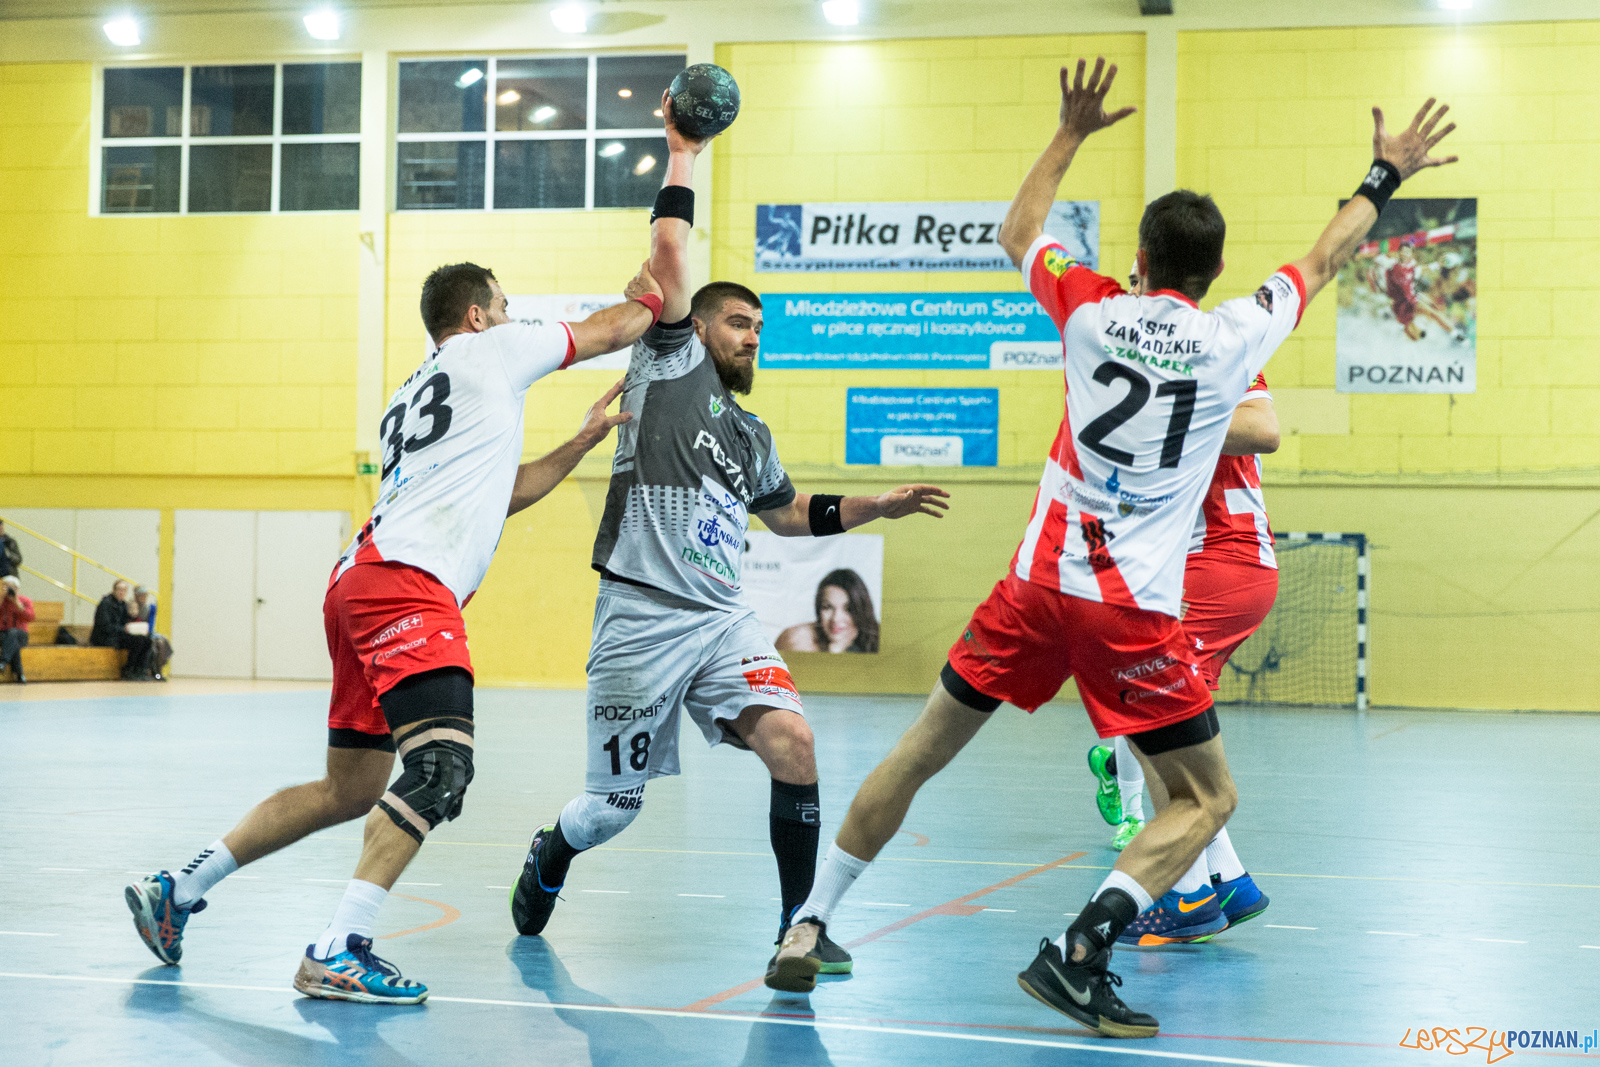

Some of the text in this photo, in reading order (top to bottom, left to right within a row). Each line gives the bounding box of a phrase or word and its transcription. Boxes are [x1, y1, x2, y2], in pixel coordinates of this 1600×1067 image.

[810, 214, 1004, 252] Piłka Ręcz
[911, 299, 988, 316] Centrum
[812, 324, 826, 335] w
[1104, 320, 1203, 355] ZAWADZKIE
[1349, 359, 1464, 384] POZNAŃ
[379, 372, 453, 482] 33
[1077, 360, 1198, 469] 21
[603, 731, 652, 776] 18
